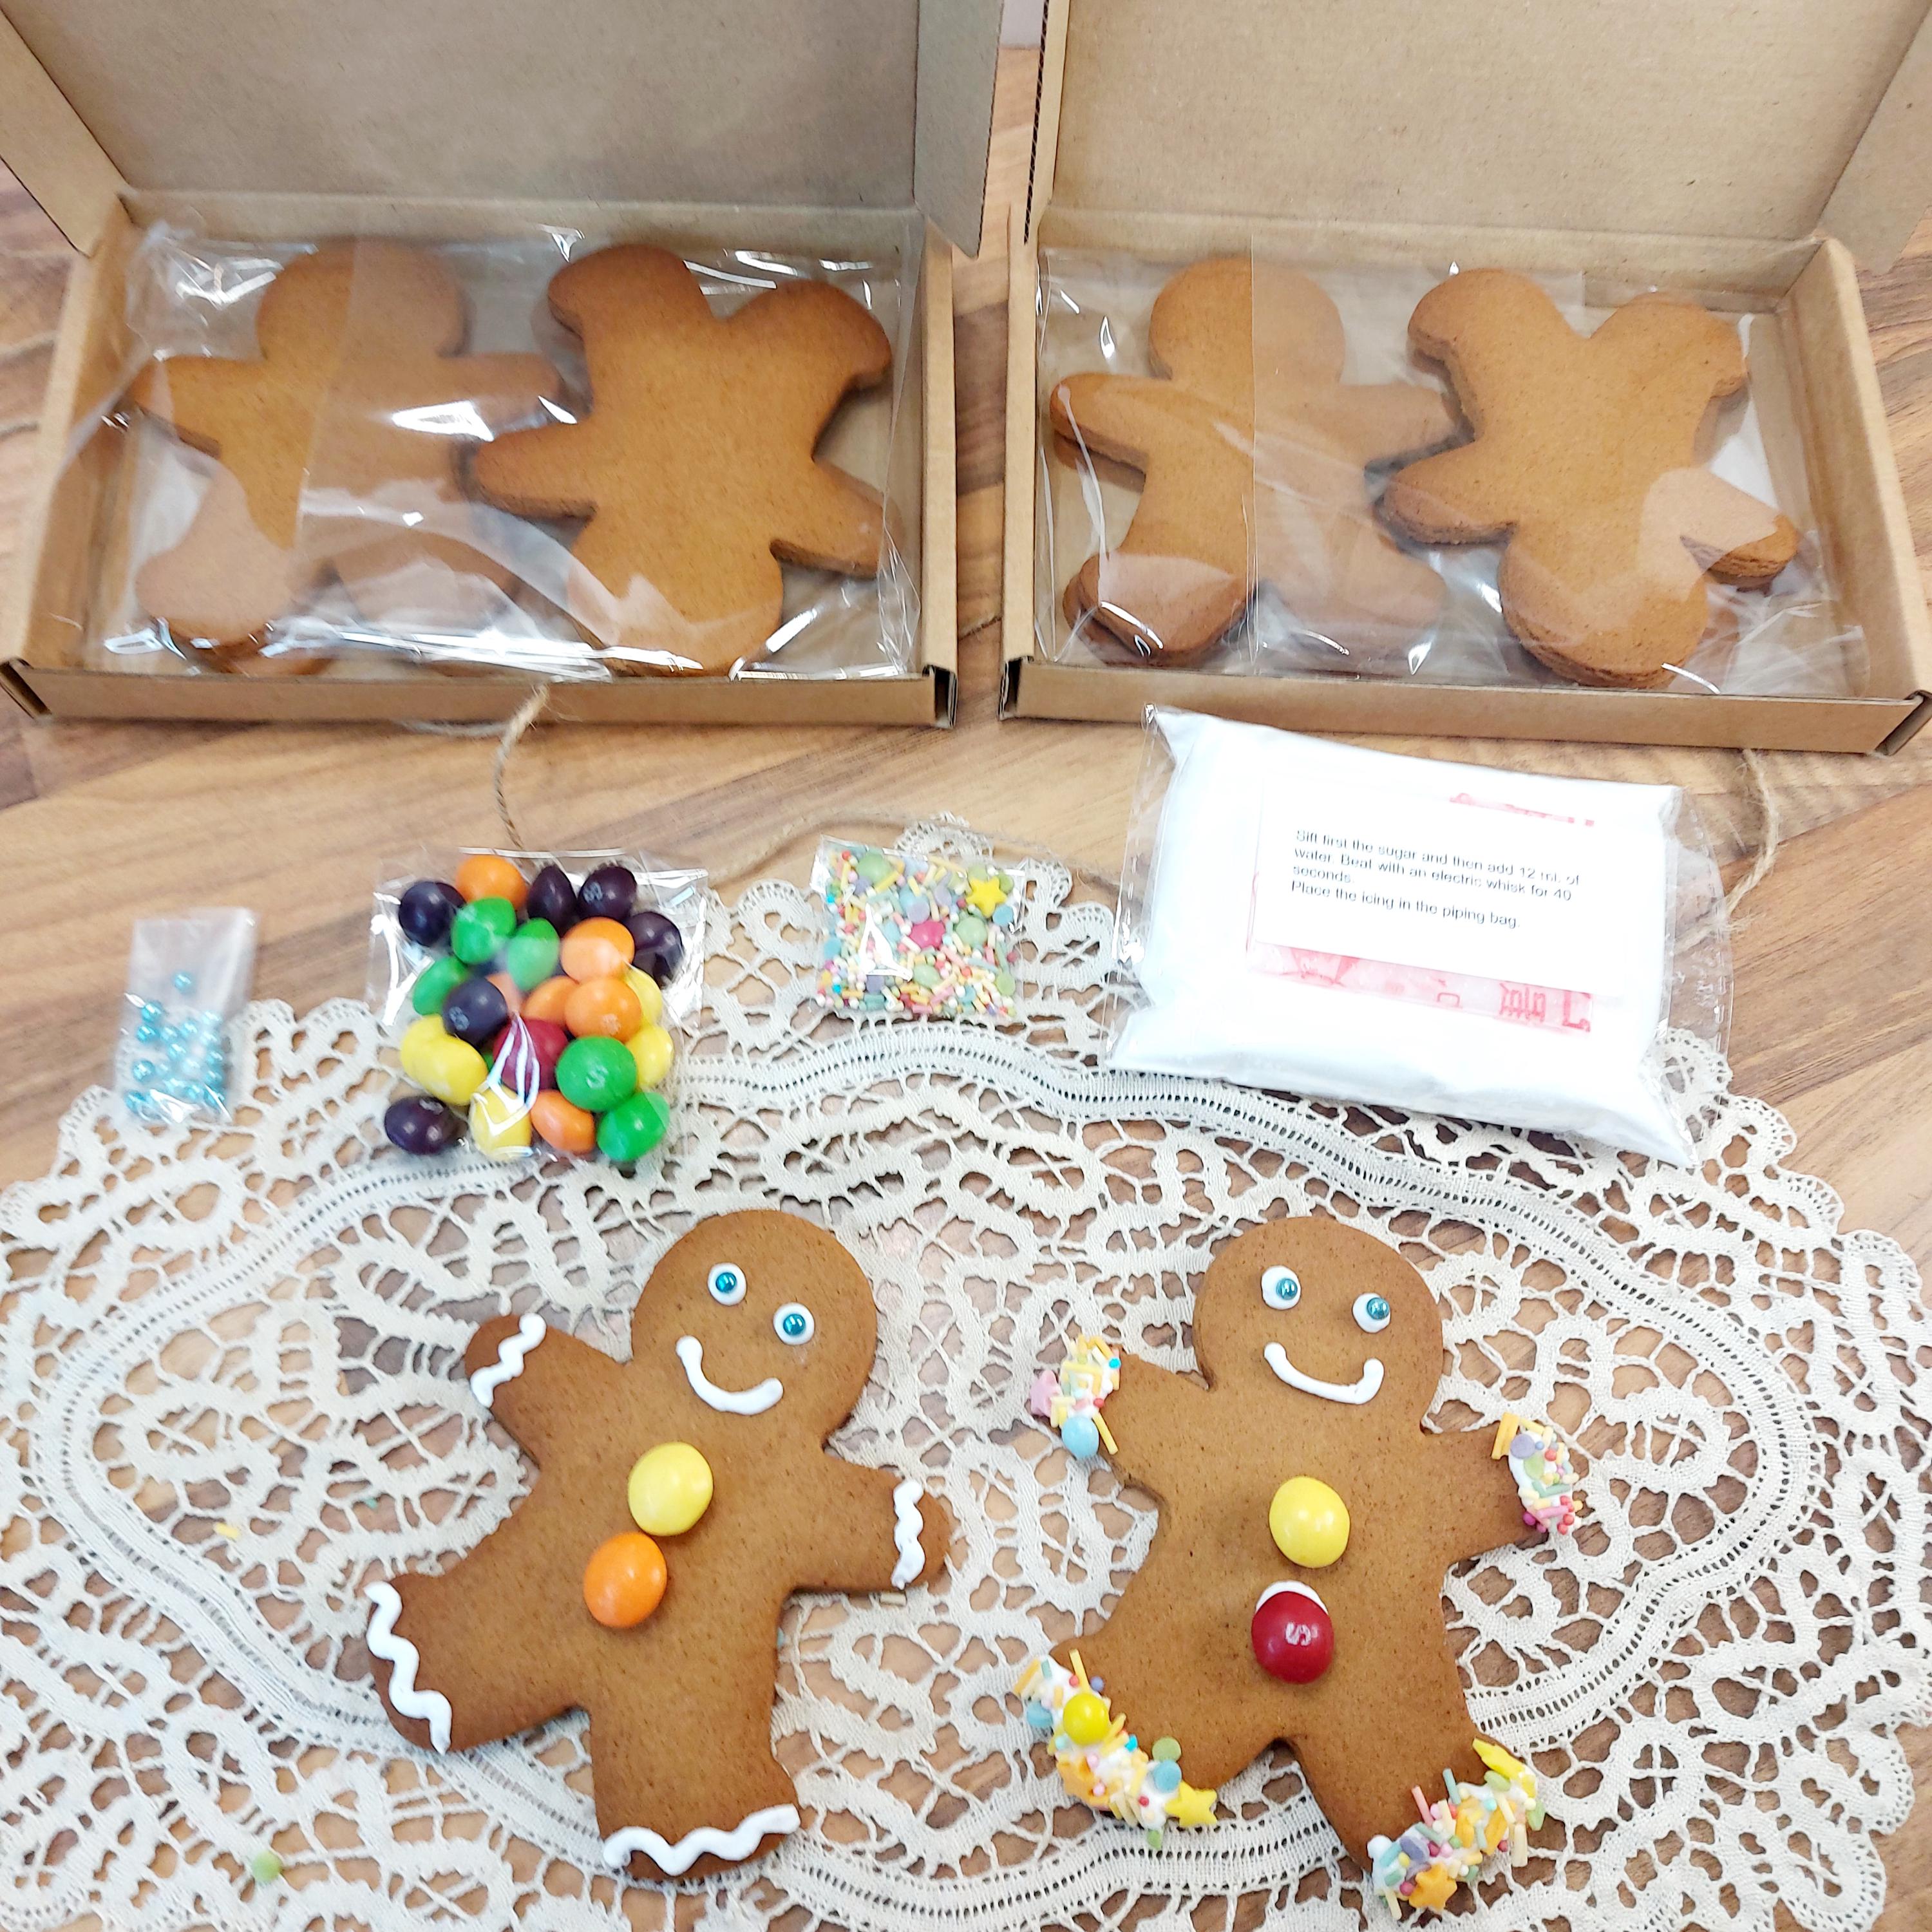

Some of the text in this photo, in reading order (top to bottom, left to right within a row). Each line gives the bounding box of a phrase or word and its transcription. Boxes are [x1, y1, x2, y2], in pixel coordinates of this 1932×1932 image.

[1296, 829, 1318, 844] Sift
[1323, 834, 1347, 849] first
[1352, 839, 1373, 853] the
[1378, 844, 1416, 860] sugar
[1422, 852, 1448, 865] and
[1453, 855, 1483, 871] then
[1487, 863, 1514, 876] add
[1519, 866, 1536, 880] 12
[1566, 874, 1580, 886] of
[1341, 853, 1372, 869] Beat
[1379, 860, 1405, 875] with
[1410, 868, 1426, 878] an
[1432, 869, 1482, 887] electric
[1487, 878, 1526, 894] whisk
[1531, 884, 1548, 898] for
[1553, 888, 1572, 901] 40
[1291, 880, 1331, 898] Place
[1336, 887, 1357, 902] the
[1362, 891, 1394, 910] icing
[1399, 897, 1411, 910] in
[1416, 900, 1437, 914] the
[1443, 905, 1485, 925] piping
[1285, 1622, 1312, 1646] S
